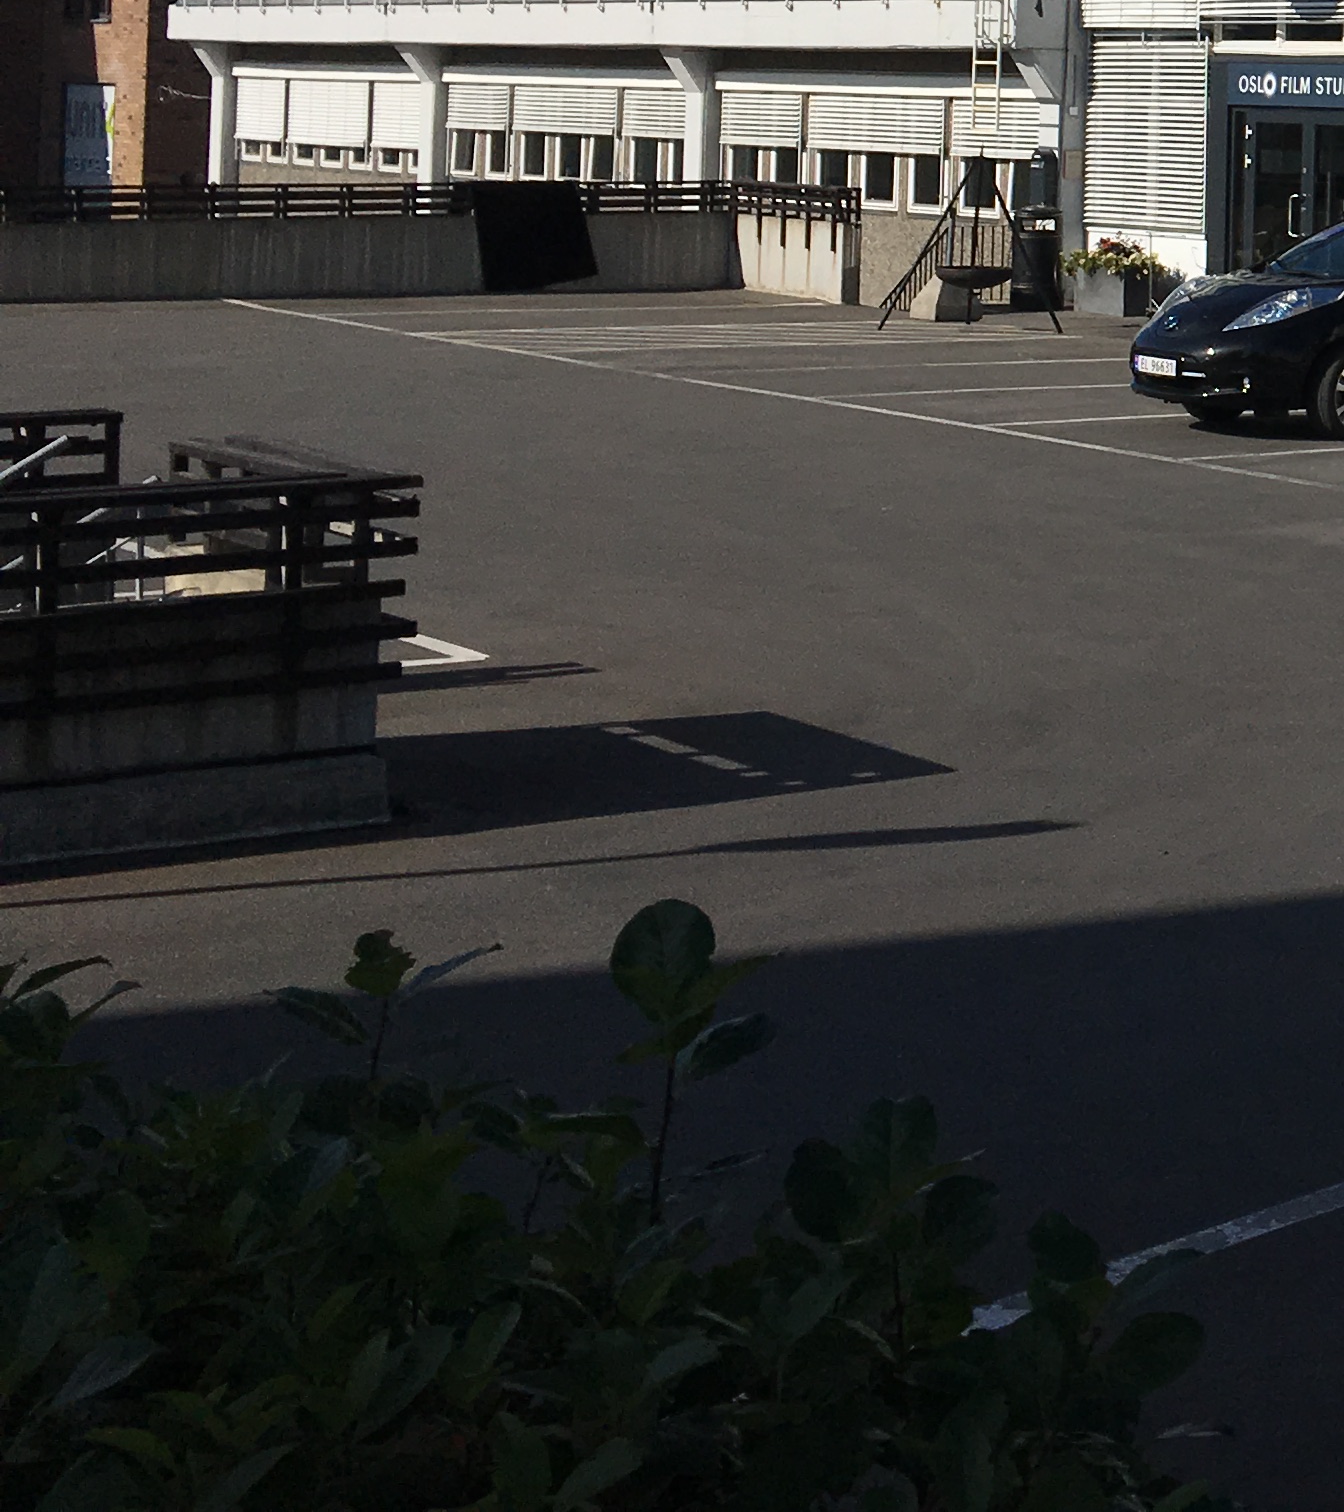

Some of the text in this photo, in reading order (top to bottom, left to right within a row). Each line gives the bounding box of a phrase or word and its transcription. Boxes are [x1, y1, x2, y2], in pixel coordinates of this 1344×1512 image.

[1238, 71, 1277, 98] OSLO
[1280, 76, 1311, 94] FILM
[1140, 357, 1149, 370] EL
